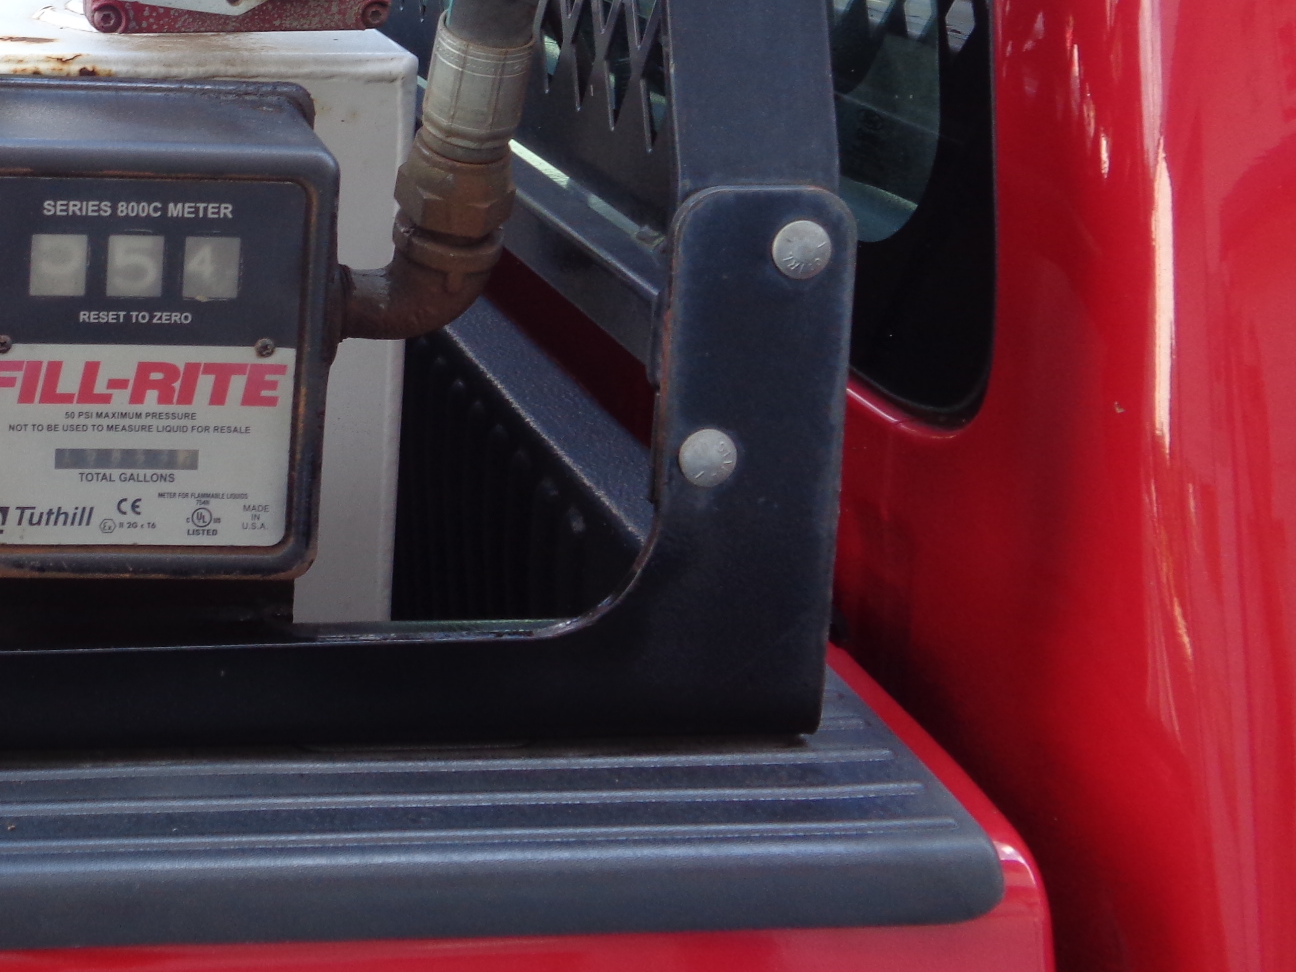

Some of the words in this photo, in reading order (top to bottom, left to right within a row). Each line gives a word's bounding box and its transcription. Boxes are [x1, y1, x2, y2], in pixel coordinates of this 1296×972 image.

[42, 200, 112, 217] SERIES
[116, 201, 162, 218] 800C
[168, 202, 234, 219] METER
[79, 311, 127, 324] RESET
[130, 311, 150, 324] TO
[152, 311, 192, 325] ZERO
[64, 411, 76, 420] 50
[78, 411, 94, 420] PSI
[95, 411, 143, 420] MAXIMUM
[145, 412, 197, 421] PRESSURE
[8, 423, 30, 432] NOT
[31, 424, 44, 432] TO
[46, 424, 60, 432] BE
[62, 424, 89, 433] USED
[90, 424, 105, 433] TO
[106, 424, 154, 433] MEASURE
[156, 425, 189, 434] LIQUID
[190, 425, 211, 434] FOR
[212, 425, 251, 434] RESALE
[79, 472, 116, 483] TOTAL
[118, 473, 175, 483] GALLONS
[190, 492, 225, 500] FLAMMABLE
[116, 497, 142, 516] CE
[242, 504, 270, 513] MADE
[14, 506, 95, 527] Tuthill
[250, 513, 261, 521] IN
[241, 522, 269, 530] U.S.A.
[186, 528, 218, 536] LISTED
